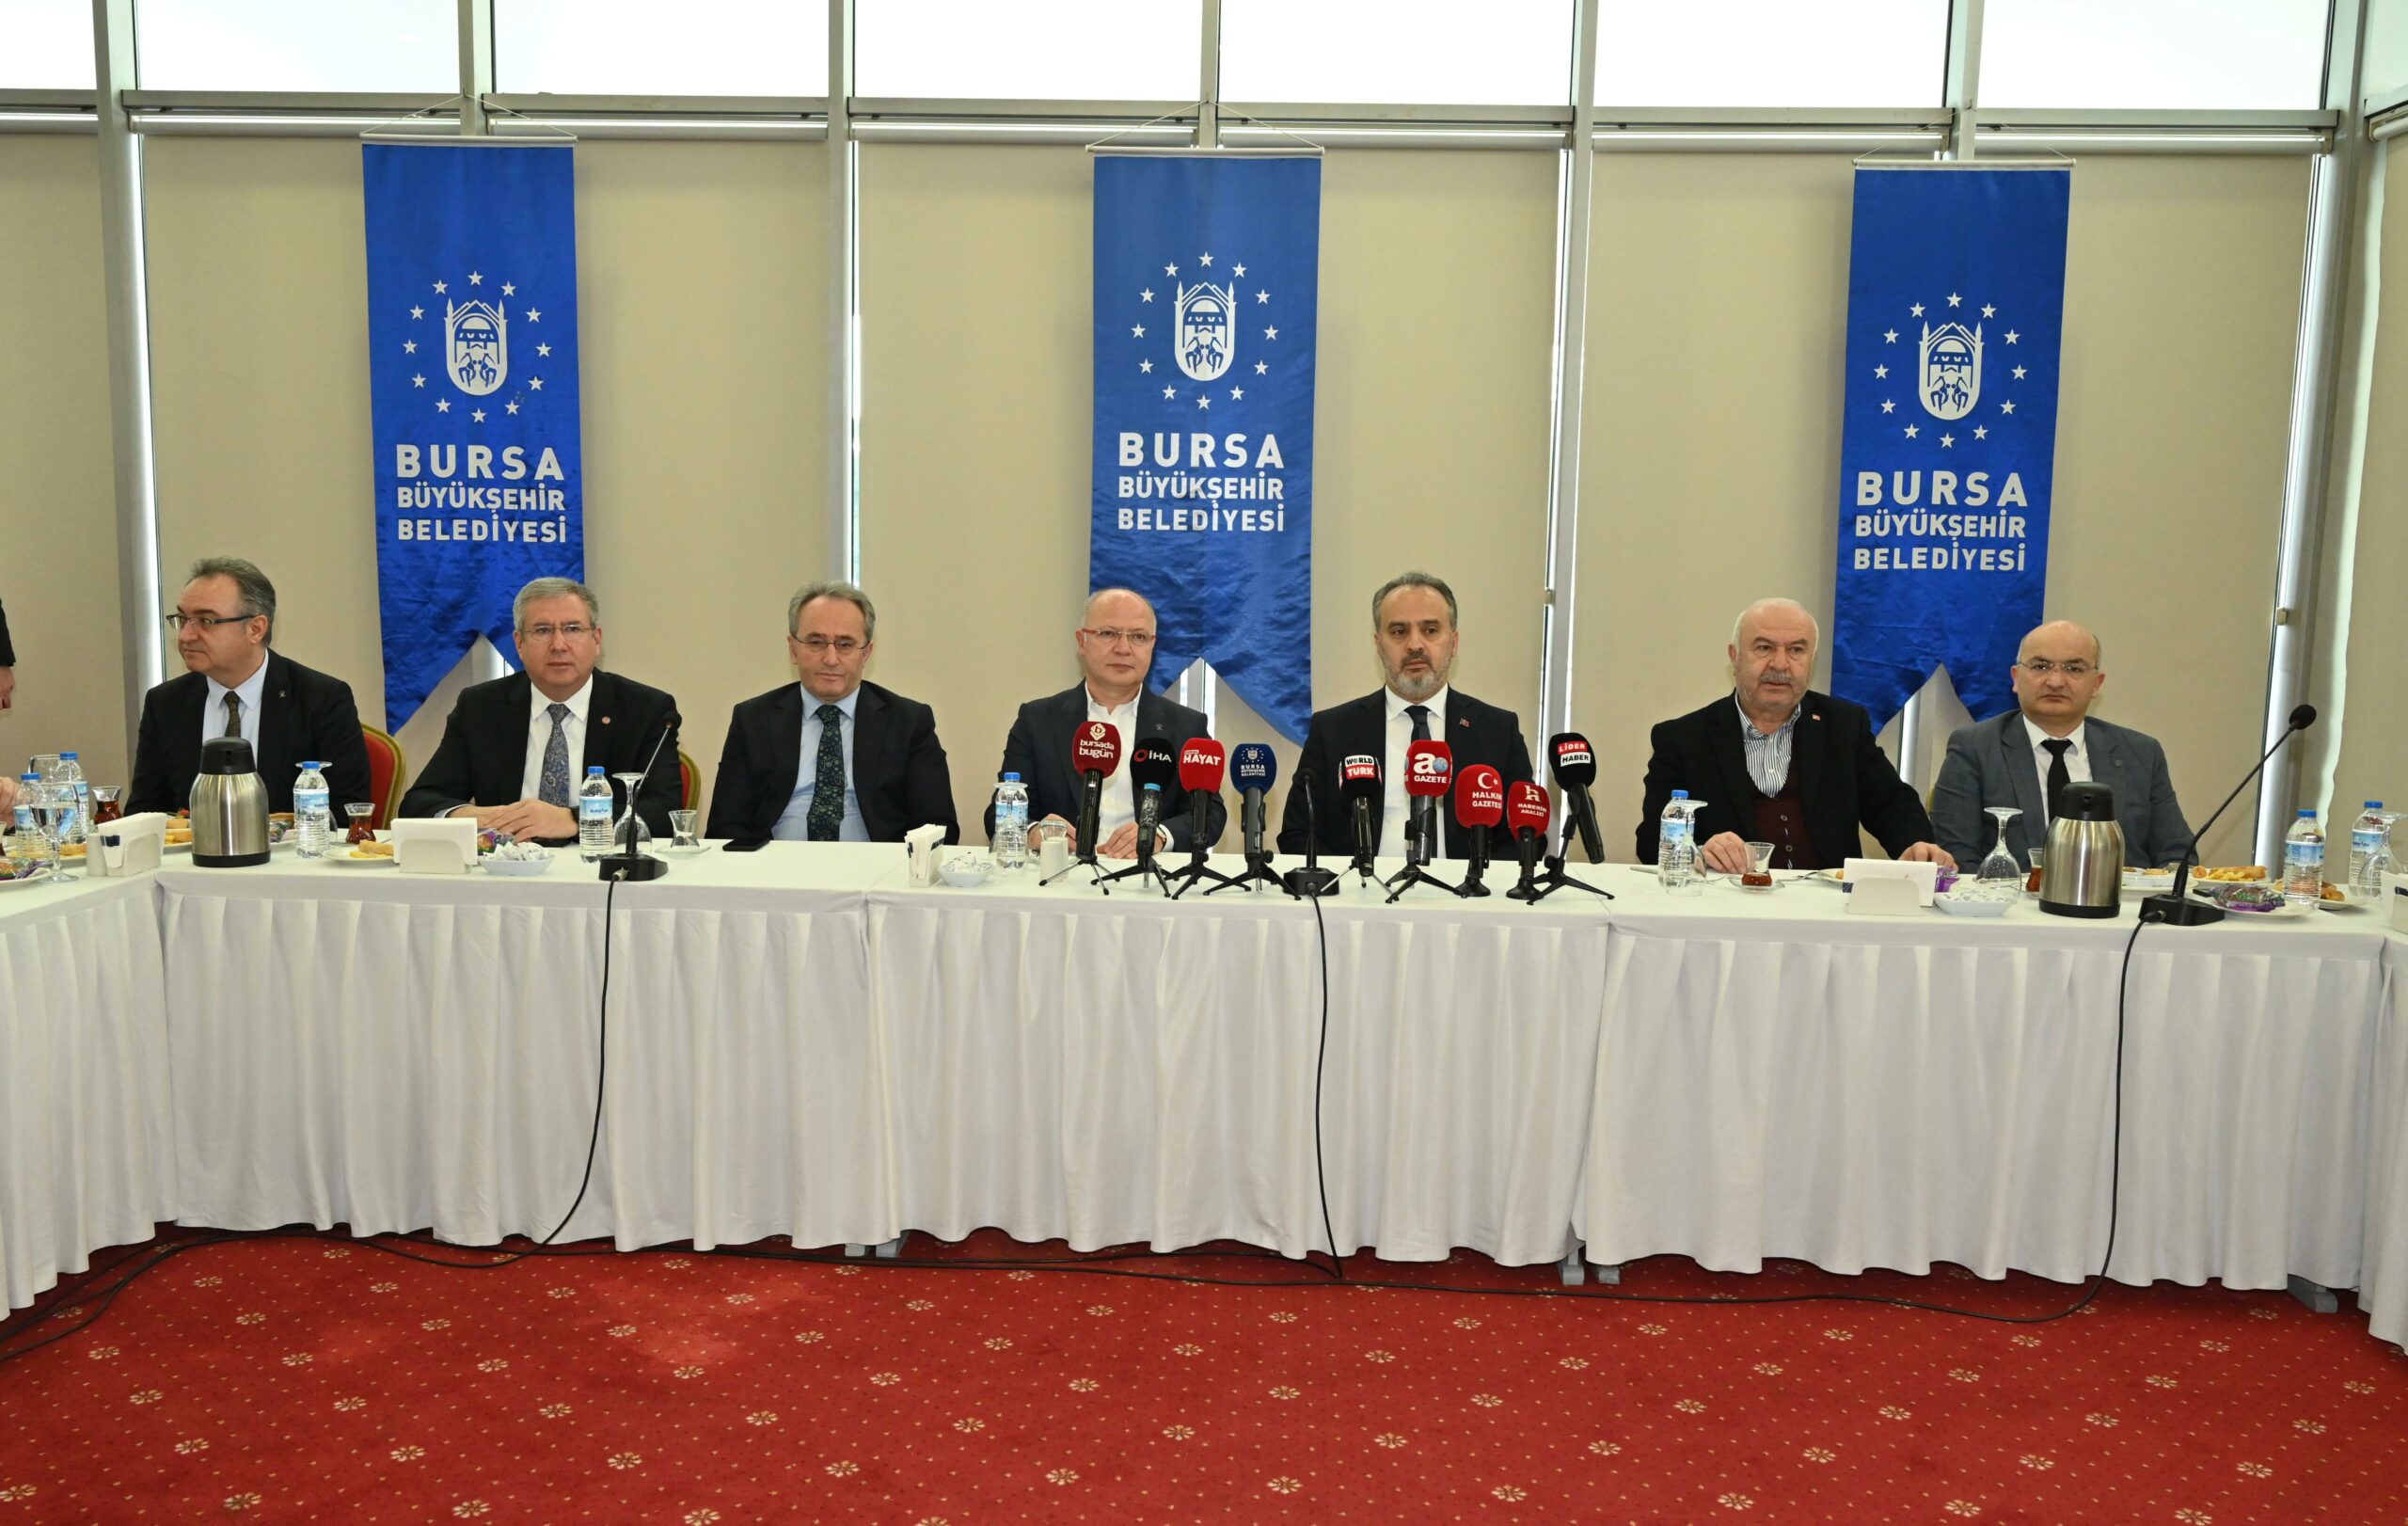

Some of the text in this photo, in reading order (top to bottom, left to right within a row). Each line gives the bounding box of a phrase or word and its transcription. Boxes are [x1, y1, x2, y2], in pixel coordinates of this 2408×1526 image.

[396, 444, 564, 481] BURSA
[1118, 432, 1285, 469] BURSA
[397, 481, 565, 514] BÜYÜKŞEHİR
[1118, 470, 1284, 503] BÜYÜKŞEHİR
[1857, 470, 2028, 507] BURSA
[398, 514, 566, 543] BELEDİYESİ
[1117, 502, 1284, 533] BELEDİYESİ
[1855, 508, 2026, 541] BÜYÜKŞEHİR
[1854, 541, 2025, 572] BELEDİYESİ
[1079, 747, 1114, 759] bugün
[1080, 739, 1115, 751] bursada
[1149, 750, 1172, 763] İHA
[1182, 754, 1221, 766] HAYAT
[1559, 742, 1586, 753] LİDER
[1561, 754, 1590, 764] HABER
[1414, 775, 1447, 784] GAZETE
